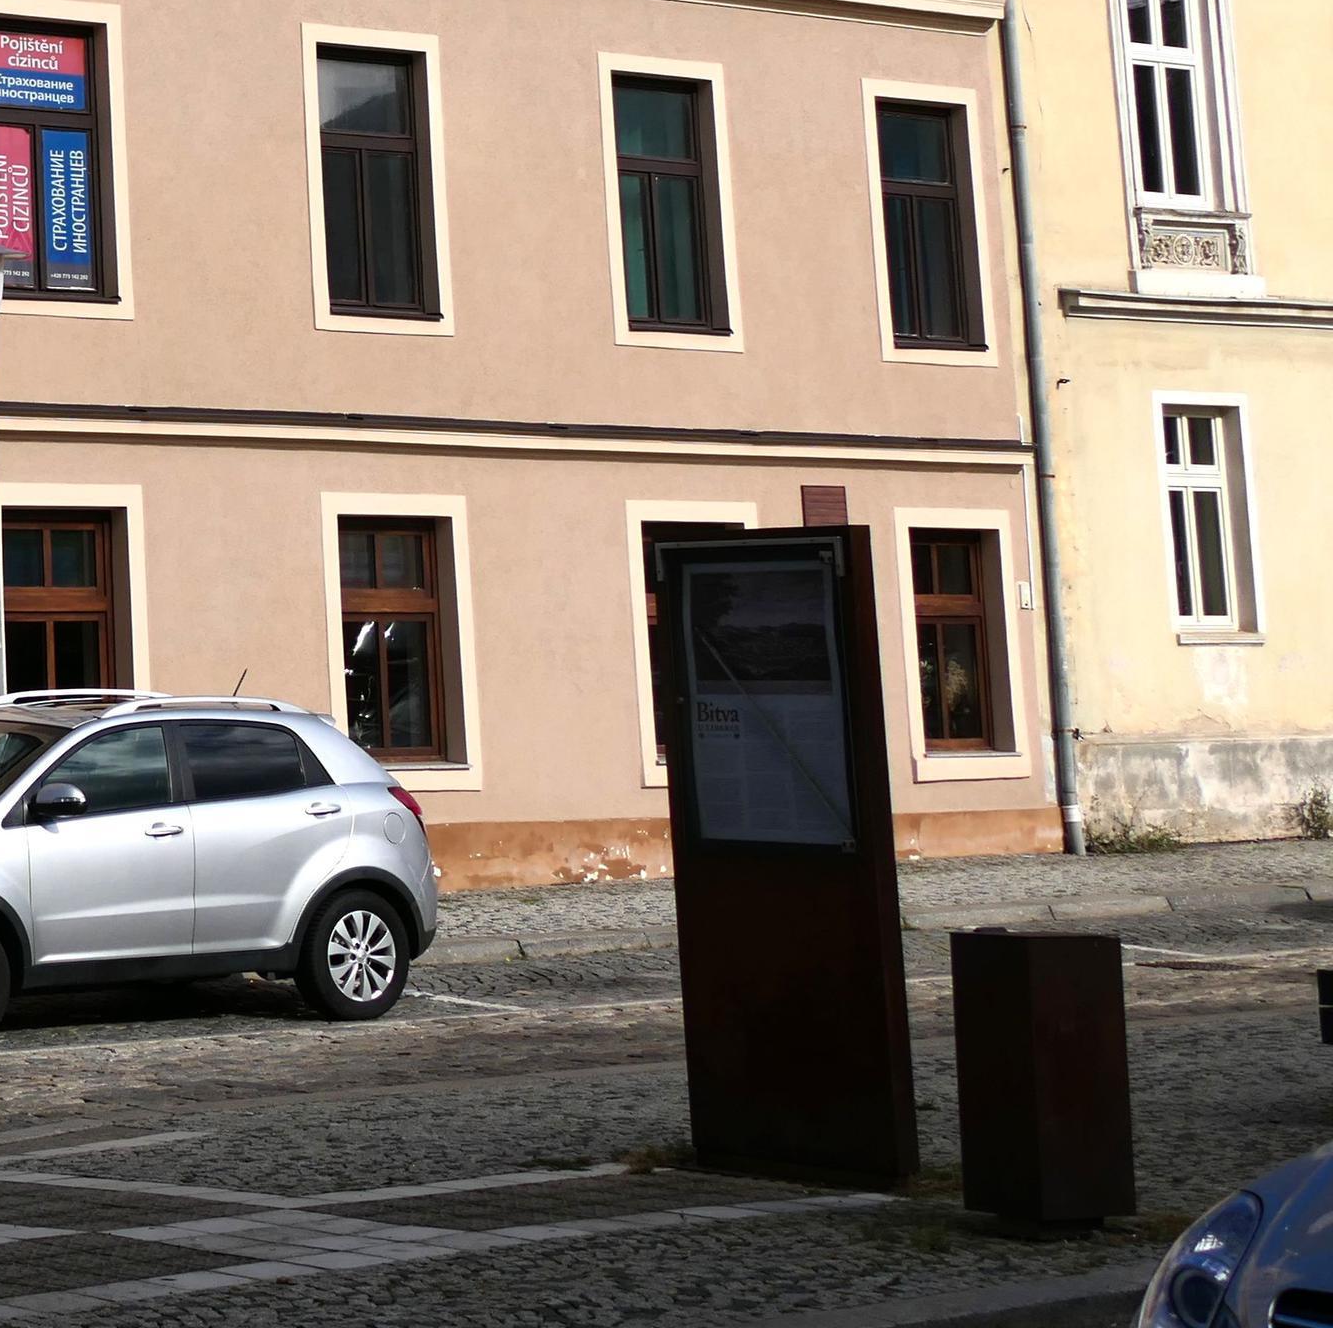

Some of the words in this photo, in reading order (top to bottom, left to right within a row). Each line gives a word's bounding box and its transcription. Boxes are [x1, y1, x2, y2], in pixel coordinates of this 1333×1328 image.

[0, 35, 63, 54] Pojištění
[8, 54, 59, 70] cizinců
[8, 164, 30, 232] CIZINCŮ
[50, 149, 68, 252] СТРАХОВАНИЕ
[69, 150, 88, 253] ИНОСТРАНЦЕВ
[696, 701, 740, 722] Bitva
